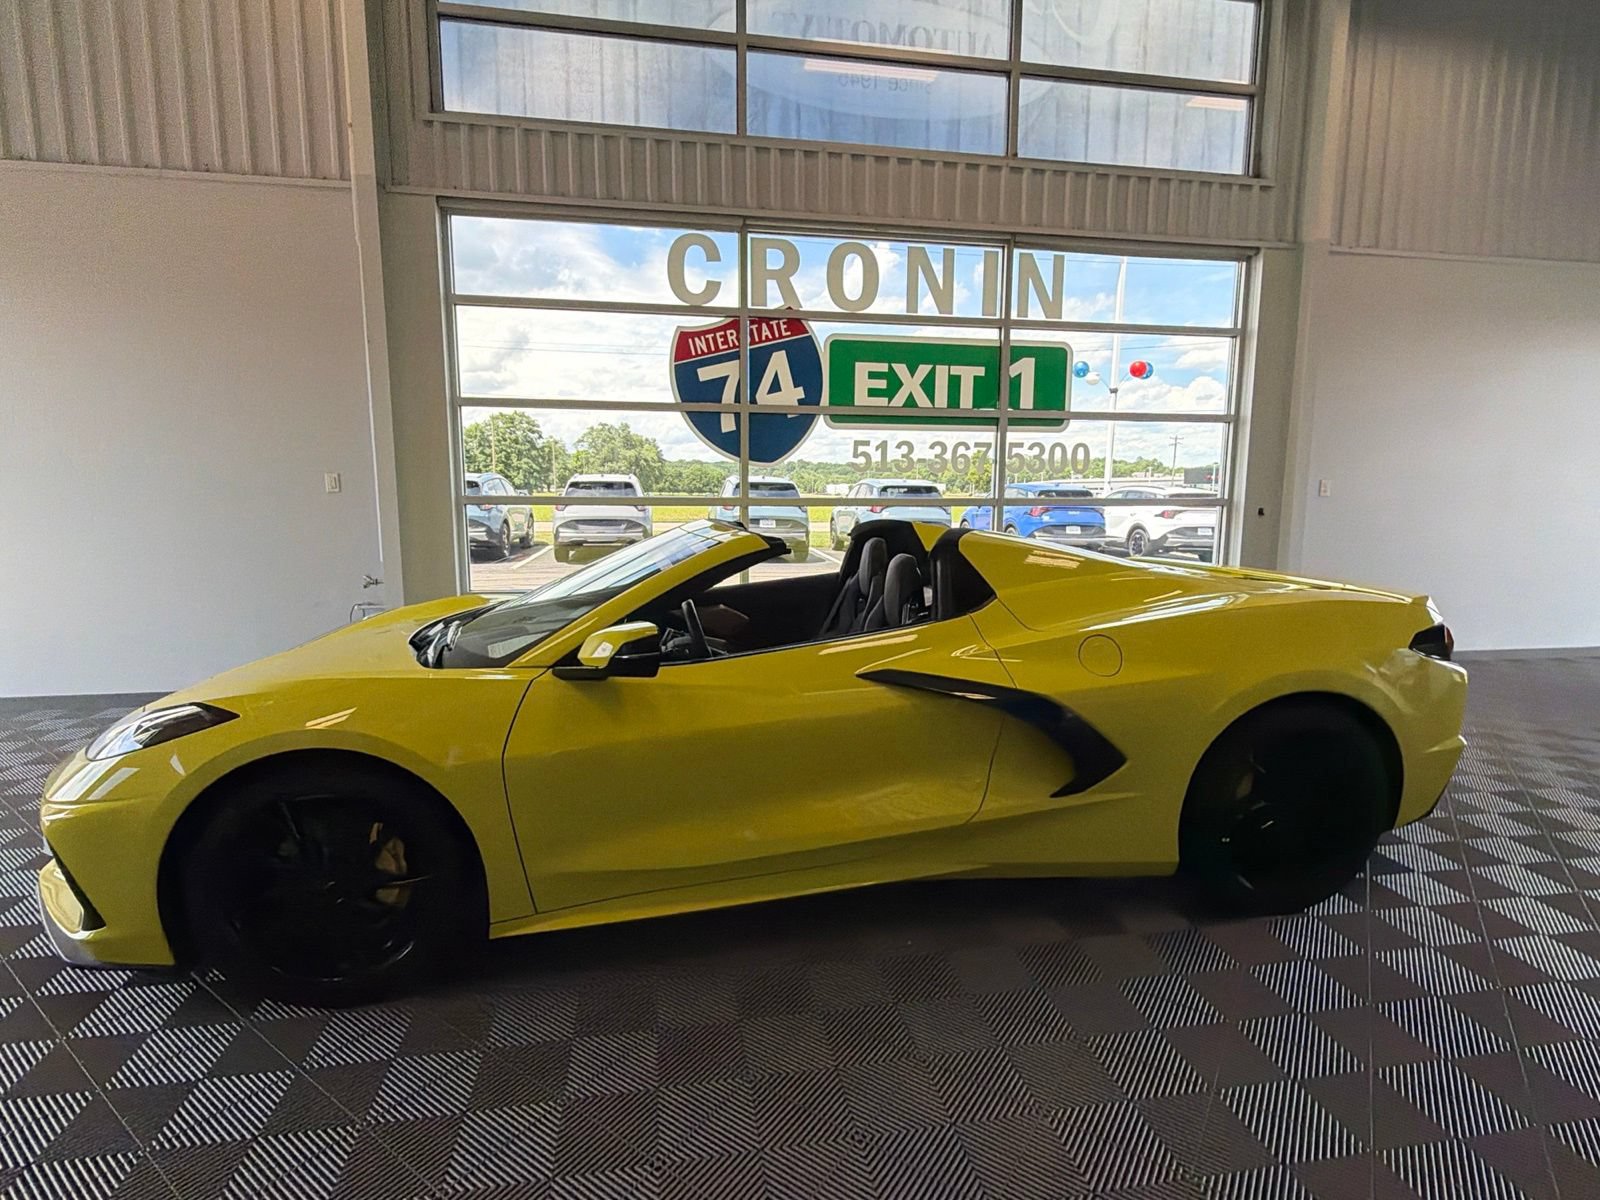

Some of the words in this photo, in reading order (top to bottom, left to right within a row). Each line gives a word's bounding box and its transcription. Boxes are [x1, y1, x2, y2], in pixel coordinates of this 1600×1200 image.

[667, 232, 1066, 320] CRONIN
[688, 318, 792, 358] INTERTATE
[696, 349, 806, 434] 74
[854, 361, 986, 409] EXIT
[1008, 357, 1036, 410] 1
[850, 439, 1091, 475] 513-3675300
